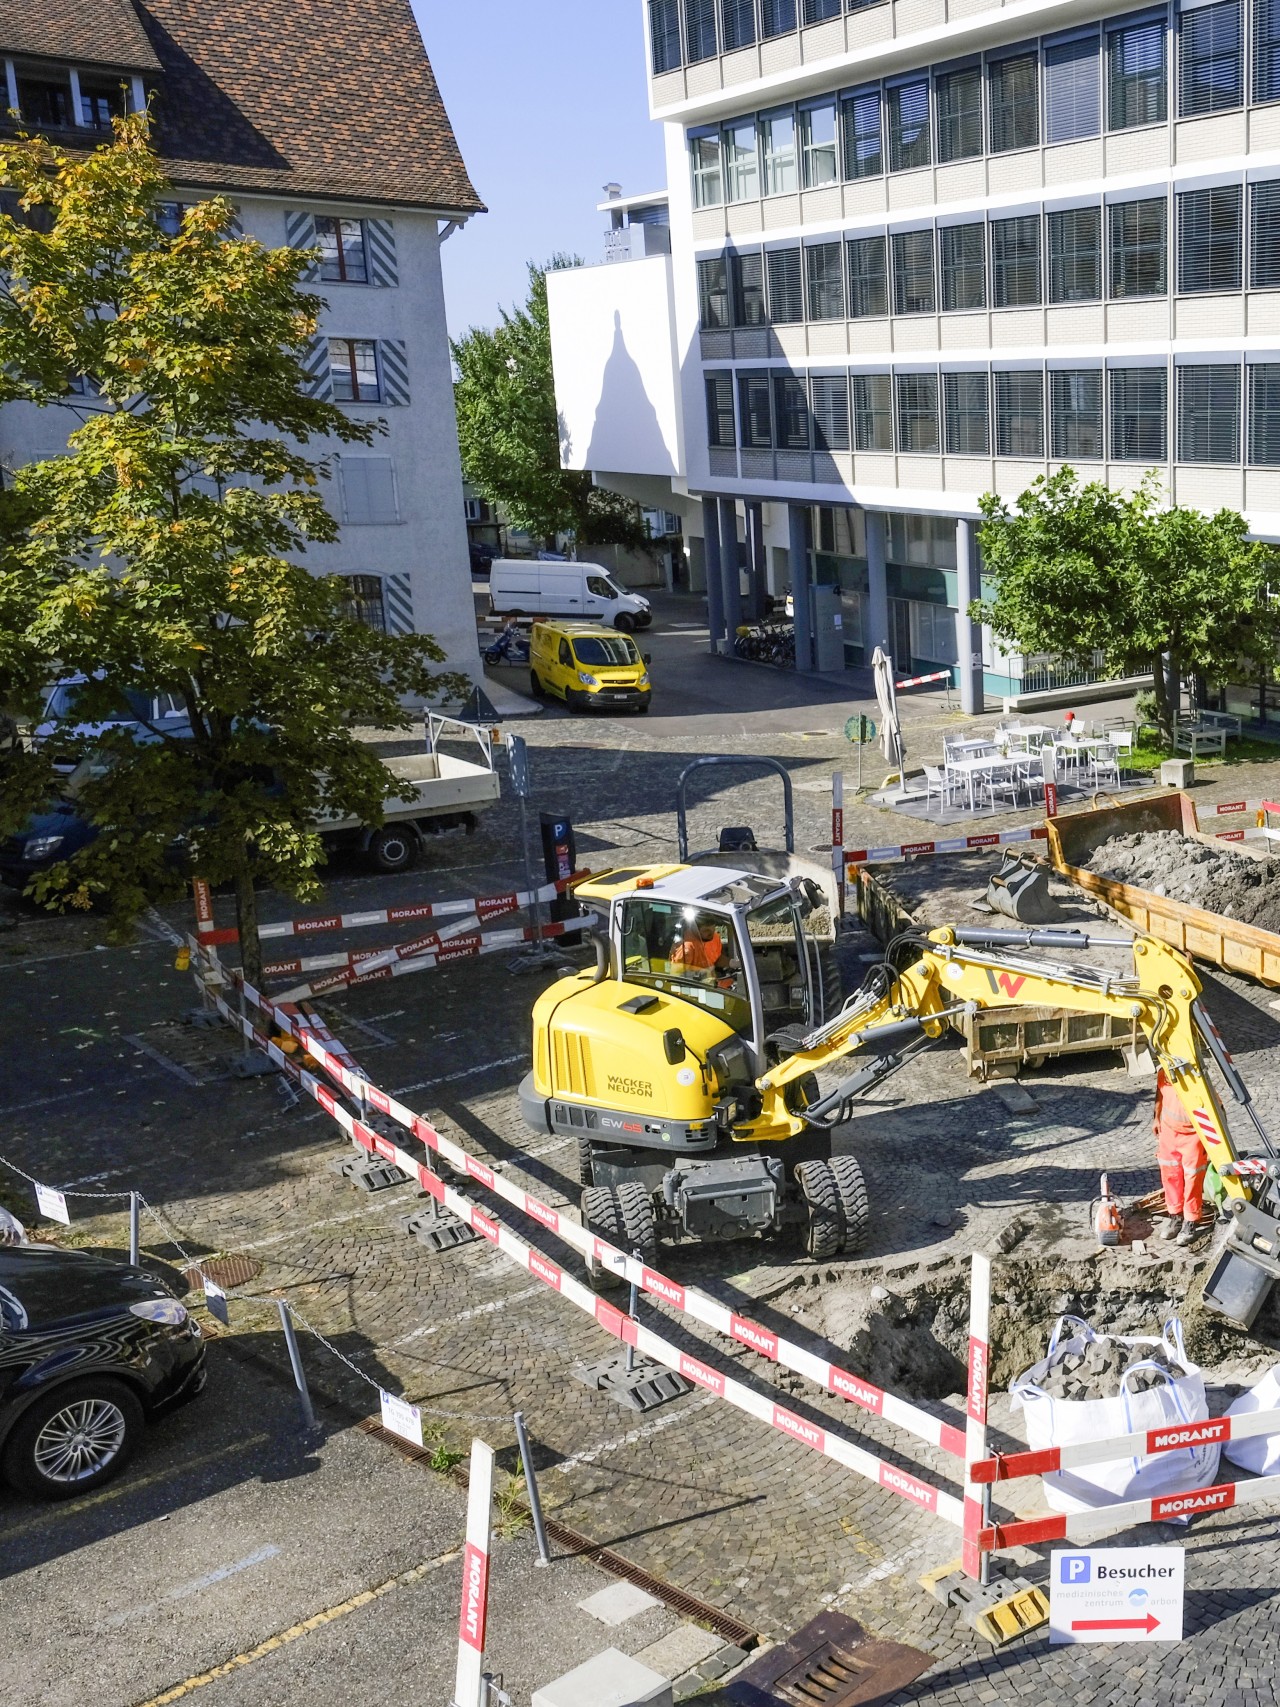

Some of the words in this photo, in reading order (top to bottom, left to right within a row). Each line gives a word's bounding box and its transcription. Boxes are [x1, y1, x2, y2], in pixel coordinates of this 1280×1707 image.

[1048, 787, 1056, 814] MORANT
[1219, 804, 1244, 812] MORANT
[970, 836, 996, 845] MORANT
[1218, 832, 1242, 841] MORANT
[904, 844, 931, 853] MORANT
[199, 882, 209, 919] MORANT
[478, 897, 513, 908] MORANT
[391, 908, 428, 919] MORANT
[481, 906, 514, 922] MORAN
[297, 919, 337, 931] MORANT
[400, 936, 434, 955] MORANT
[441, 937, 478, 948] MORANT
[438, 948, 473, 962] MORANT
[263, 963, 297, 974] ORANT
[313, 971, 350, 991] MORANT
[350, 970, 387, 985] MORANT
[607, 1075, 652, 1090] WACKER
[607, 1084, 653, 1098] NEUSON
[601, 1118, 642, 1133] EW65
[467, 1159, 493, 1185] MORANT
[527, 1202, 557, 1226] MORANT
[473, 1213, 498, 1239] MORANT
[531, 1257, 559, 1285] MORANT
[646, 1276, 683, 1302] MORANT
[734, 1323, 775, 1352] MORANT
[683, 1360, 721, 1388] MORANT
[972, 1345, 983, 1416] MORANT
[833, 1374, 879, 1407] MORANT
[776, 1410, 820, 1442] MORANT
[1154, 1425, 1224, 1448] MORANT
[883, 1470, 932, 1503] MORANT
[1159, 1492, 1227, 1514] MORANT
[1097, 1564, 1175, 1579] Besucher
[466, 1553, 481, 1640] MORANT
[1056, 1589, 1124, 1599] medizinisches
[1150, 1598, 1178, 1606] arbon
